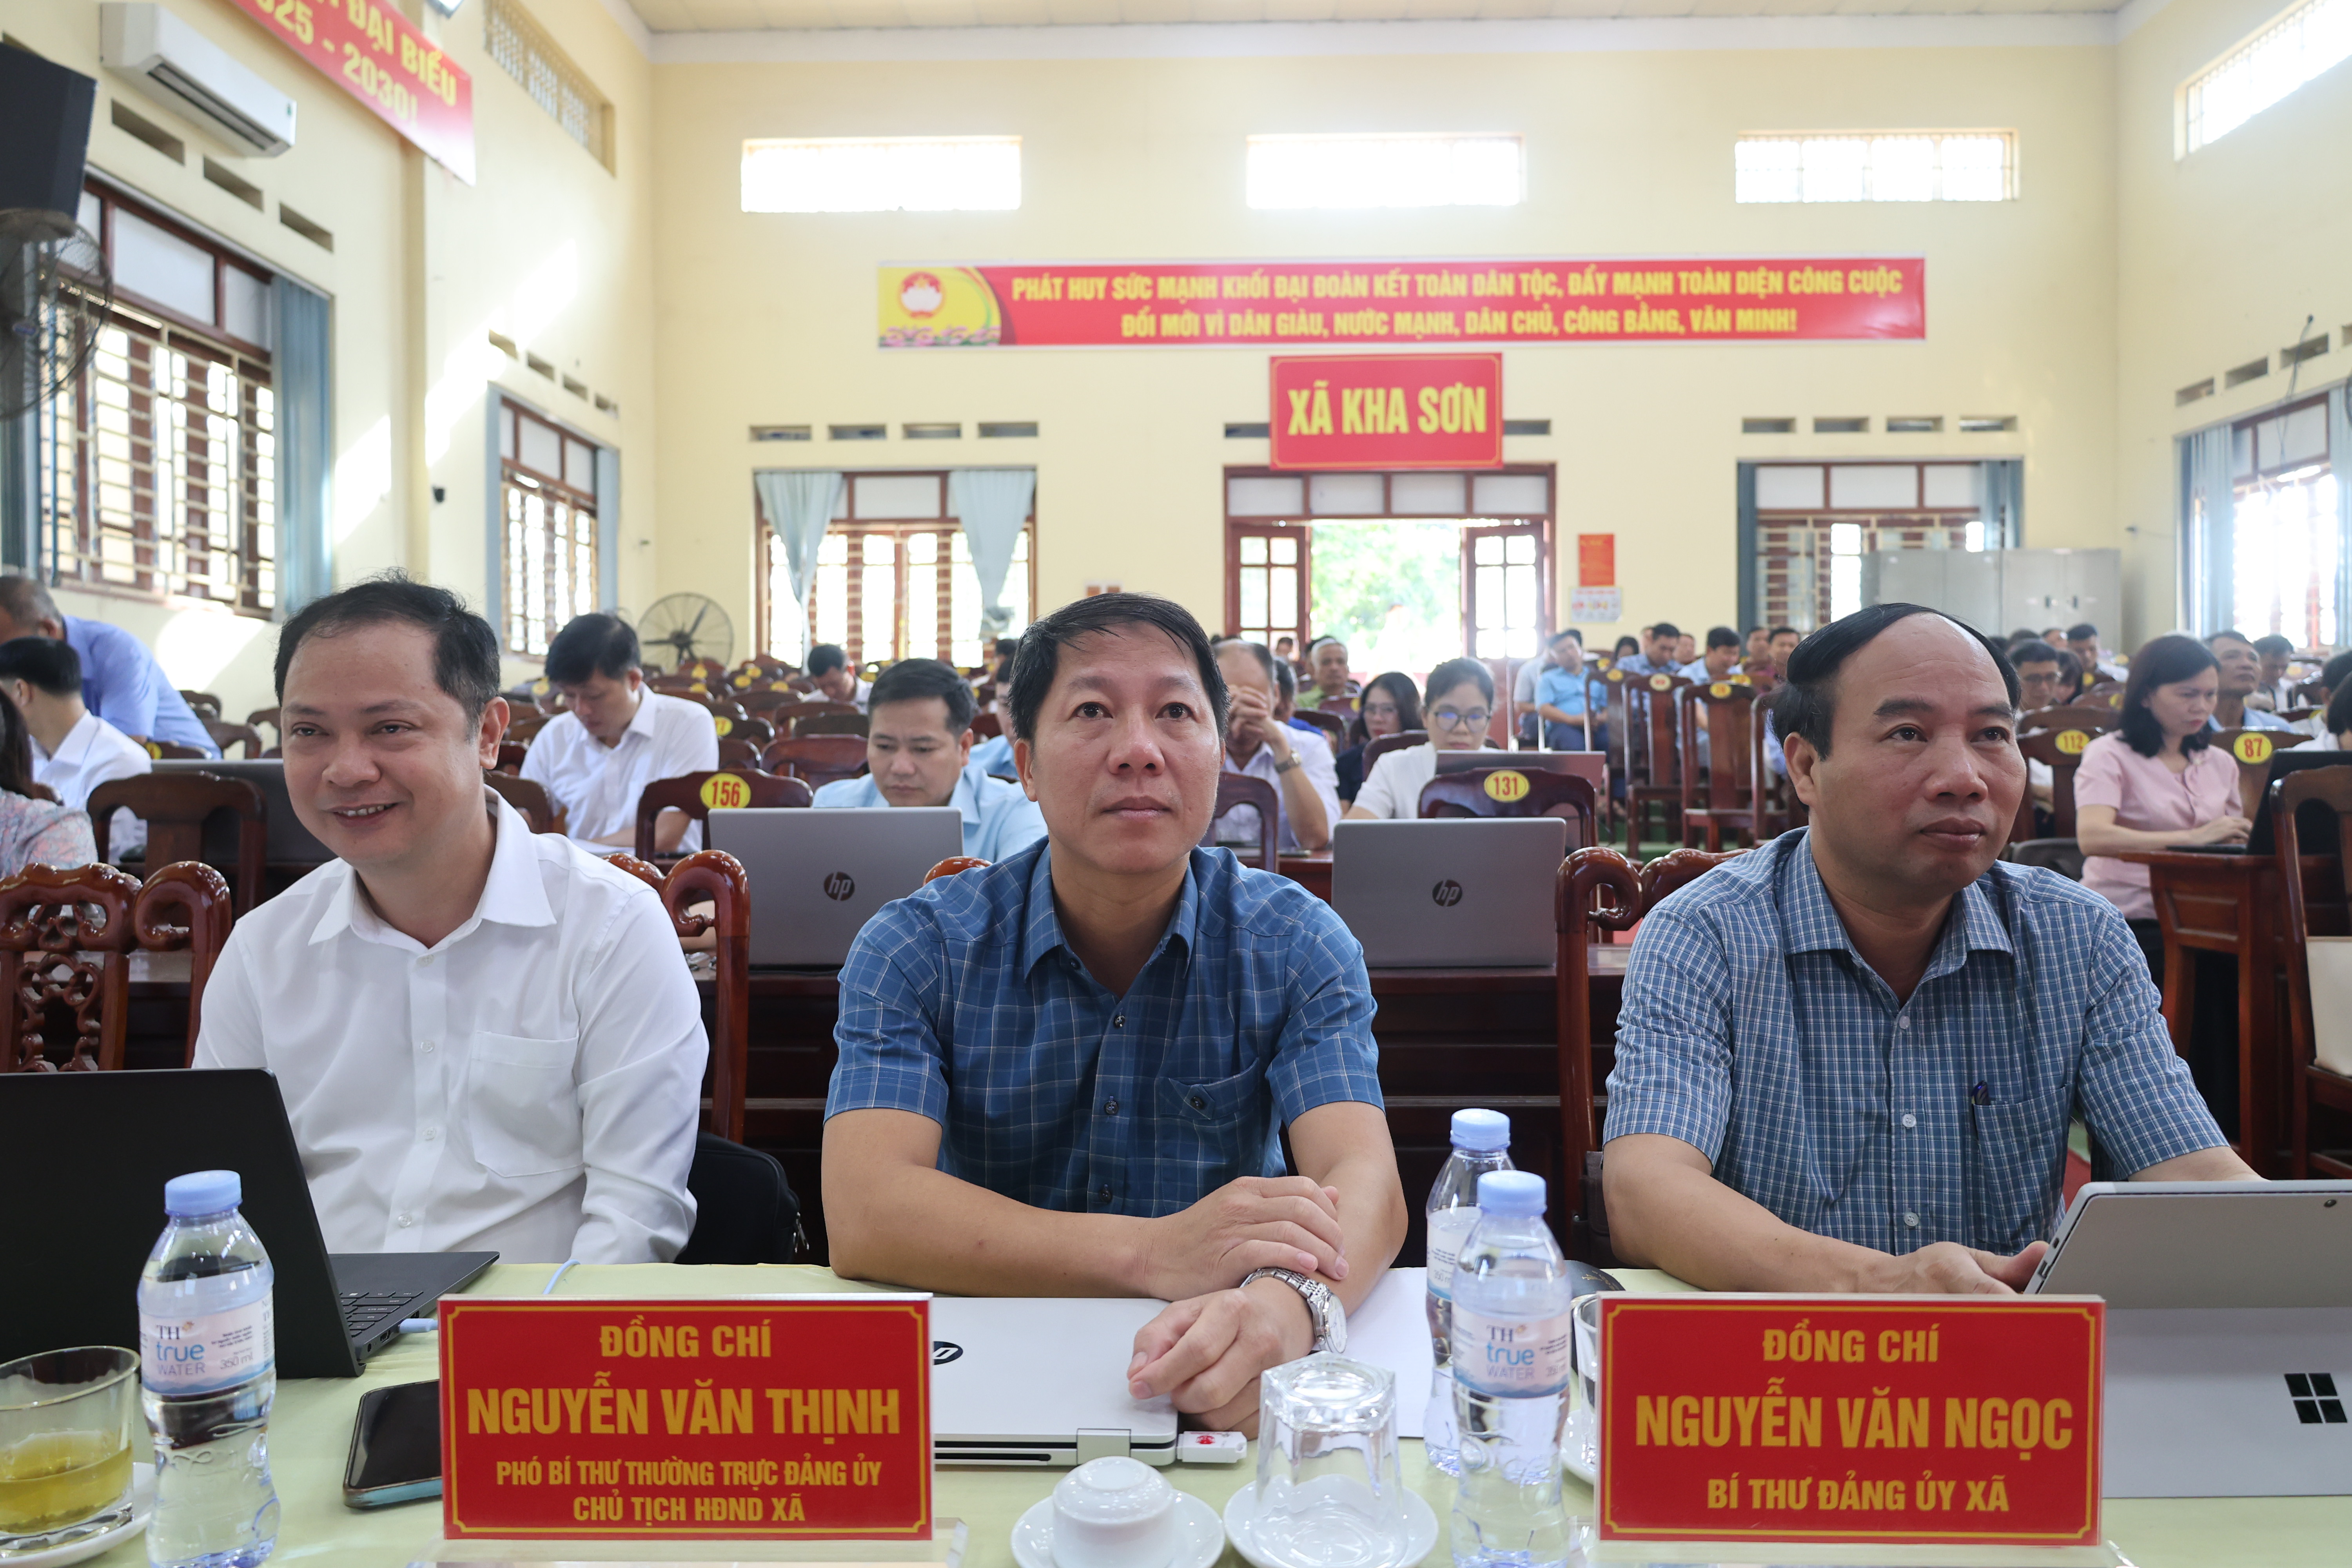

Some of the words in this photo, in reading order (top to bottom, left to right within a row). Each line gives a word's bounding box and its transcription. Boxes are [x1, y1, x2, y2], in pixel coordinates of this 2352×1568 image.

[401, 32, 457, 107] BIỂU
[1012, 273, 1065, 301] PHÁT
[1067, 276, 1108, 300] HUY
[1111, 272, 1154, 301] SỨC
[1156, 276, 1218, 304] MẠNH
[1373, 269, 1411, 298] KẾT
[1414, 270, 1468, 298] TOÀN
[1612, 271, 1675, 303] MẠNH
[1677, 267, 1732, 295] TOÀN
[1735, 266, 1784, 299] DIỆN
[1788, 266, 1844, 295] CÔNG
[1847, 265, 1903, 298] CUỘC
[1121, 305, 1157, 338] ĐỔI
[1160, 310, 1200, 337] MỚI
[1204, 309, 1225, 337] VÌ
[1229, 309, 1272, 336] DÂN
[1275, 308, 1330, 338] GIÀU,
[1333, 308, 1390, 336] NƯỚC
[1393, 311, 1461, 340] MẠNH,
[1465, 306, 1508, 335] DÂN
[1511, 303, 1560, 336] CHỦ,
[1563, 305, 1620, 334] CÔNG
[1623, 301, 1686, 334] BẰNG,
[1689, 304, 1732, 332] VĂN
[1735, 308, 1797, 332] MINH!
[1288, 379, 1334, 436] XÃ
[1341, 387, 1410, 435] KHA
[1417, 382, 1487, 434] SƠN
[2244, 738, 2263, 758] 87
[712, 780, 740, 808] 156
[1494, 776, 1518, 796] 131
[824, 871, 855, 901] hp
[1432, 879, 1463, 907] hp
[156, 1325, 180, 1340] TH
[600, 1315, 699, 1357] ĐỒNG
[712, 1319, 771, 1357] CHÍ
[1486, 1325, 1514, 1342] TH
[1879, 1324, 1938, 1362] CHÍ
[156, 1341, 205, 1362] true
[1486, 1341, 1534, 1365] true
[158, 1361, 206, 1376] WATER
[1486, 1365, 1535, 1381] WATER
[468, 1371, 648, 1434] NGUYỄN
[661, 1379, 753, 1435] VĂN
[766, 1388, 899, 1445] THỊNH
[1637, 1377, 1822, 1447] NGUYỄN
[1837, 1387, 1929, 1448] VĂN
[1945, 1397, 2072, 1460] NGỌC
[497, 1456, 542, 1485] PHÓ
[549, 1456, 571, 1485] BÍ
[577, 1459, 622, 1485] THƯ
[625, 1456, 714, 1486] THƯỜNG
[720, 1459, 778, 1491] TRỰC
[784, 1453, 847, 1486] ĐẢNG
[853, 1453, 881, 1486] ỦY
[1708, 1472, 1738, 1508] BÍ
[1749, 1477, 1813, 1510] THƯ
[1818, 1471, 1906, 1510] ĐẢNG
[1916, 1470, 1955, 1511] ỦY
[1966, 1475, 2009, 1511] XÃ
[574, 1489, 623, 1521] CHỦ
[631, 1497, 686, 1526] TỊCH
[695, 1497, 763, 1521] HĐND
[772, 1493, 805, 1521] XÃ
